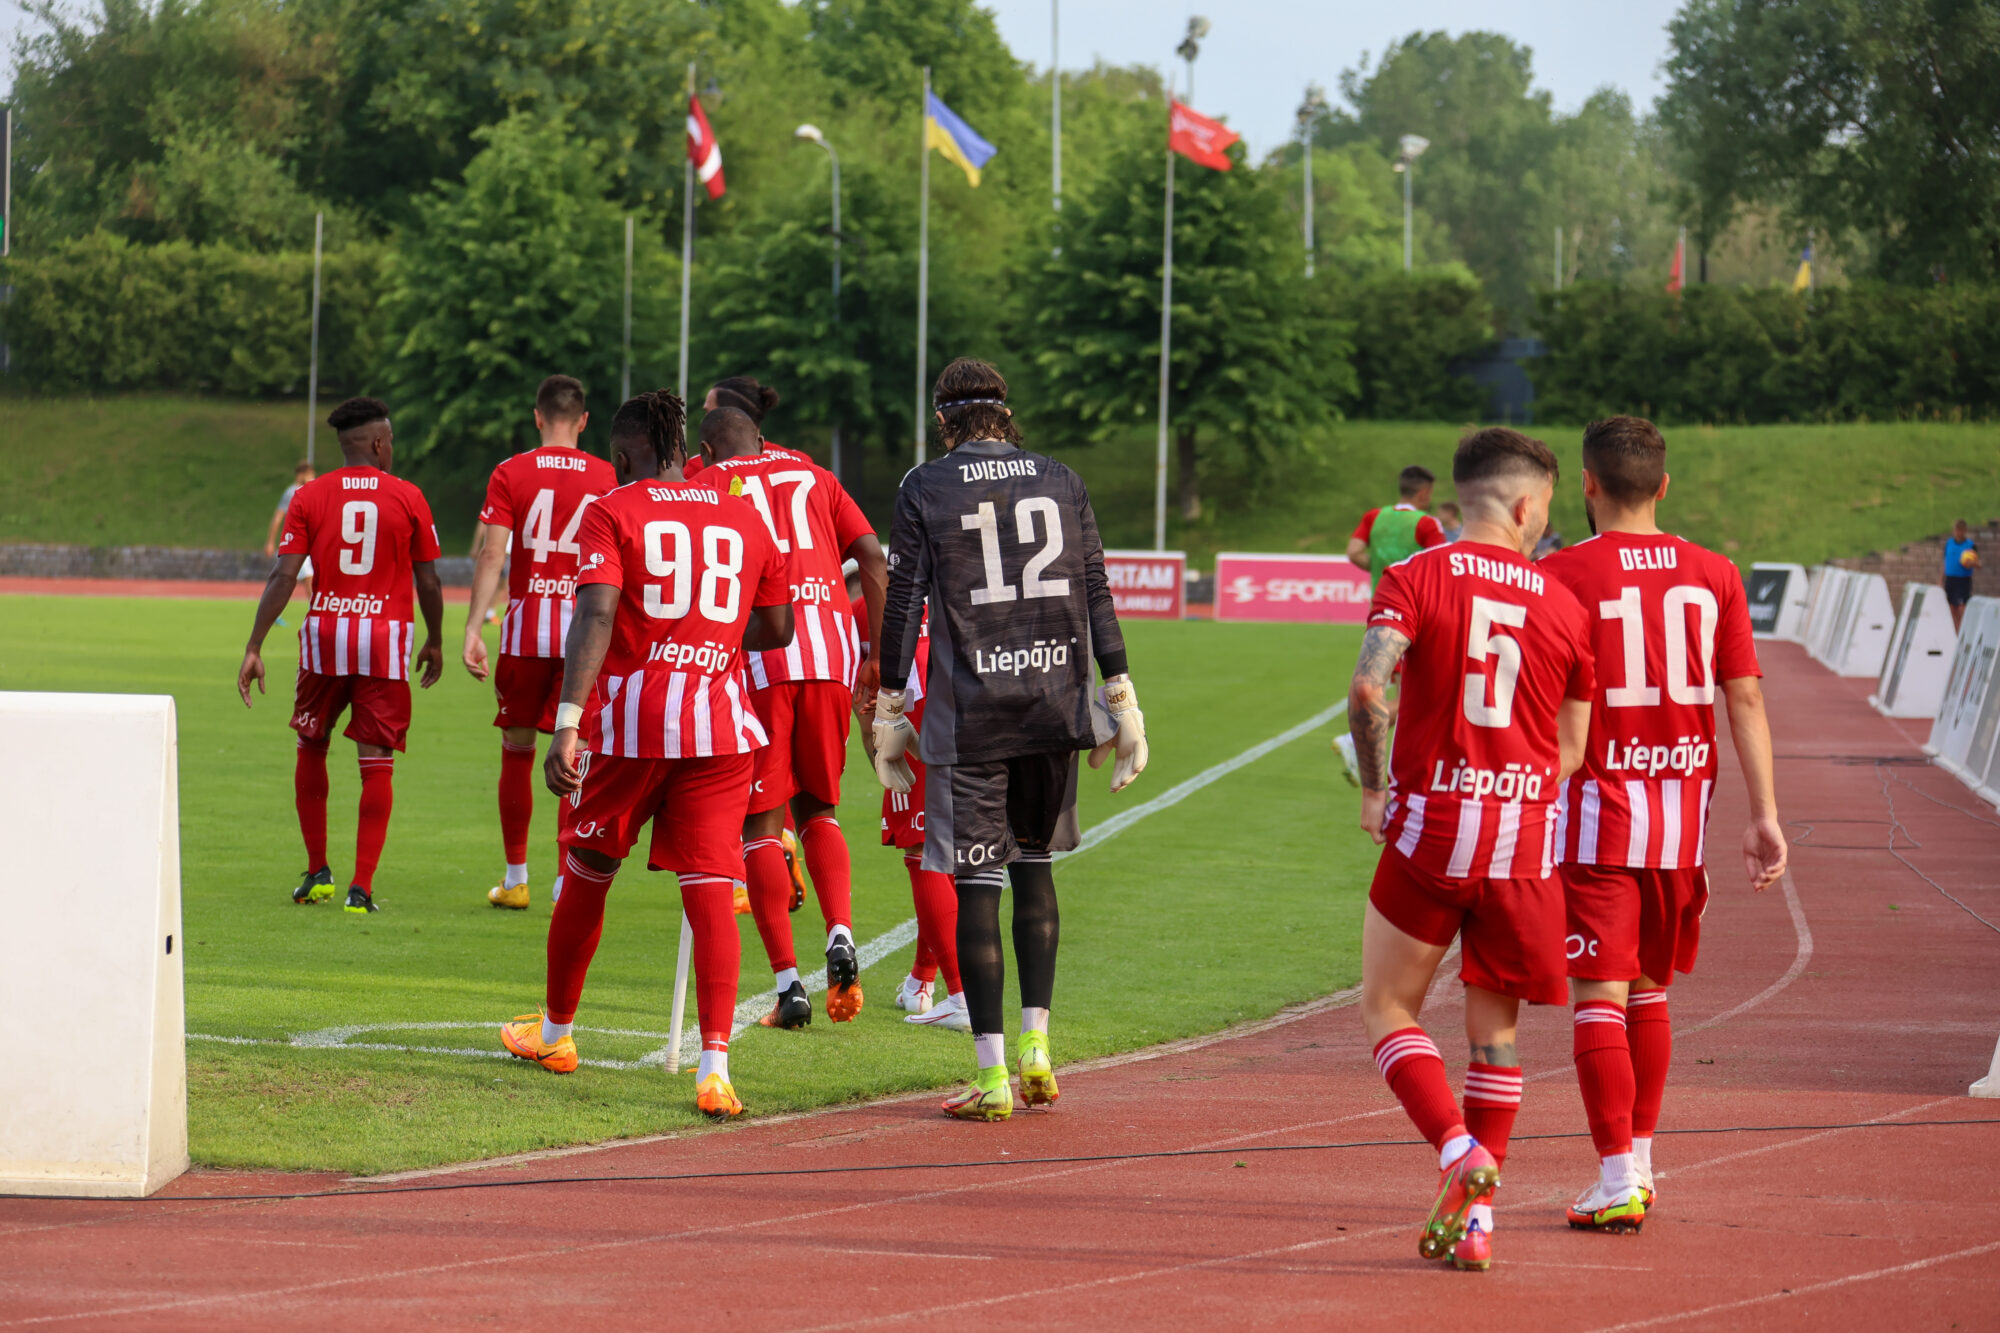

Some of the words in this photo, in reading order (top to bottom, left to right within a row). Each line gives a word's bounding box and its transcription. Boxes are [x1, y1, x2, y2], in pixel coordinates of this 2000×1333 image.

[536, 455, 587, 472] HRELJIC
[741, 470, 817, 554] 17
[339, 500, 379, 576] 9
[961, 496, 1070, 606] 12
[1618, 546, 1678, 571] DELIU
[643, 520, 744, 624] 98
[1449, 552, 1545, 597] STRUMIA
[312, 591, 383, 619] Liepāja
[976, 639, 1068, 676] Liepāja
[1464, 596, 1527, 728] 5
[1599, 585, 1719, 708] 10
[1606, 735, 1710, 777] Liepāja
[1430, 758, 1542, 804] Liepāja
